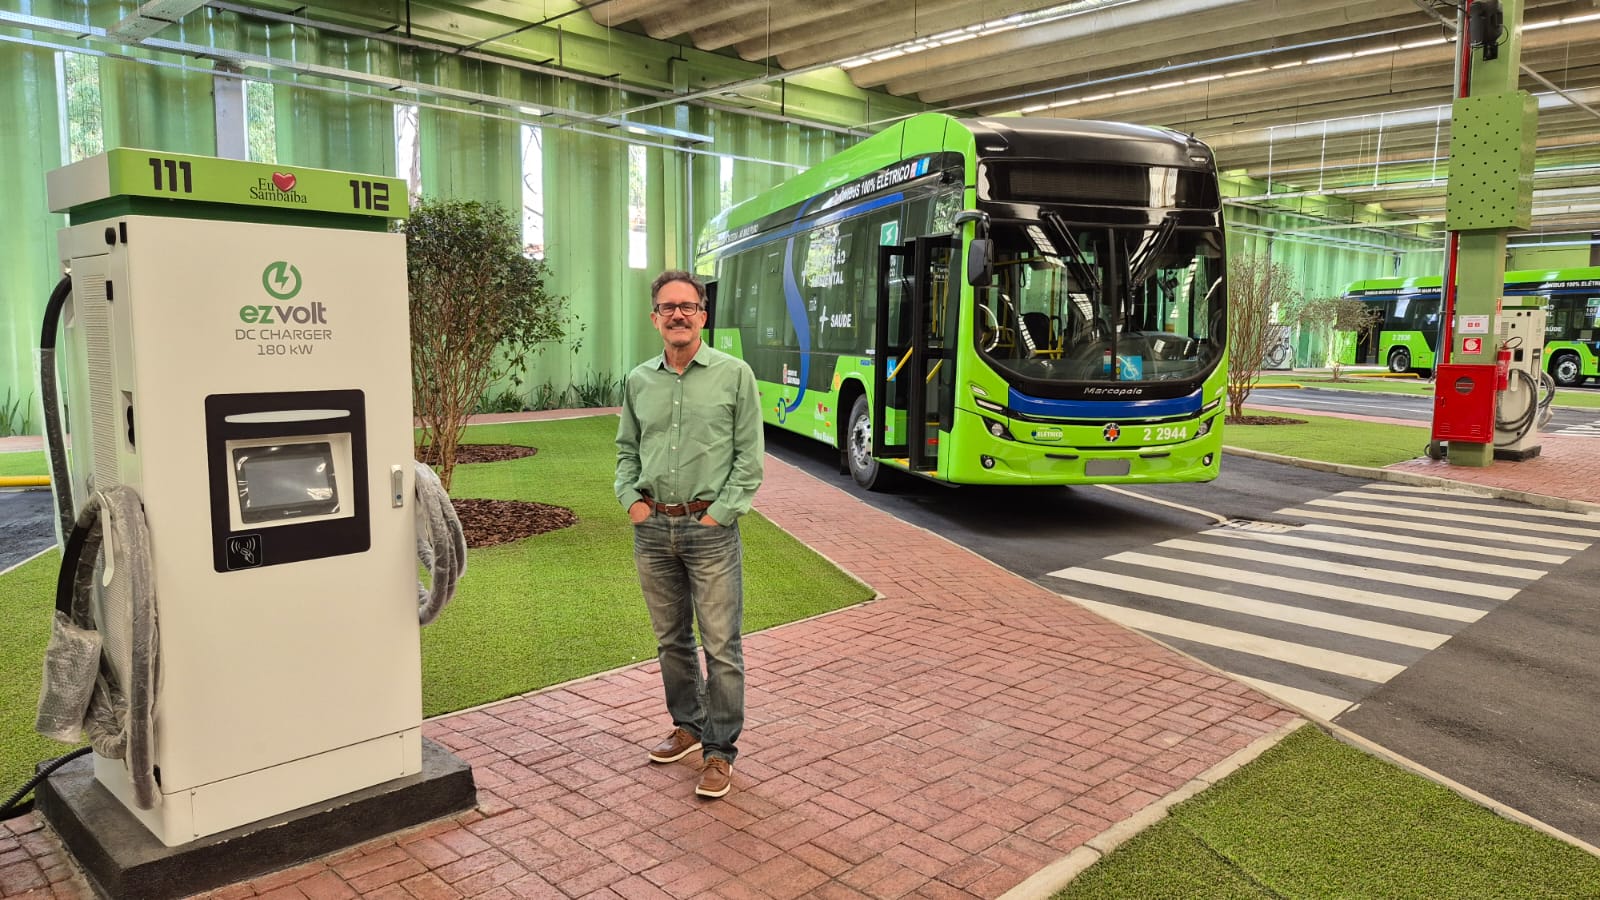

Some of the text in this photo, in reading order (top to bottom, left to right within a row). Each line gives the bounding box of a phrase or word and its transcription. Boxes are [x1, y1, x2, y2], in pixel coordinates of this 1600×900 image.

[149, 158, 192, 193] 111
[861, 177, 876, 197] 100%
[876, 164, 911, 190] ELÉTRICO
[258, 178, 275, 191] Eu
[249, 186, 308, 203] Sambaíba
[349, 180, 389, 211] 112
[239, 301, 327, 324] ezvolt
[830, 311, 852, 328] SAÚDE
[235, 329, 332, 340] DC CHARGER
[257, 344, 313, 356] 180 kW
[1083, 387, 1143, 396] Marcopolo
[1143, 426, 1187, 441] 2 2944
